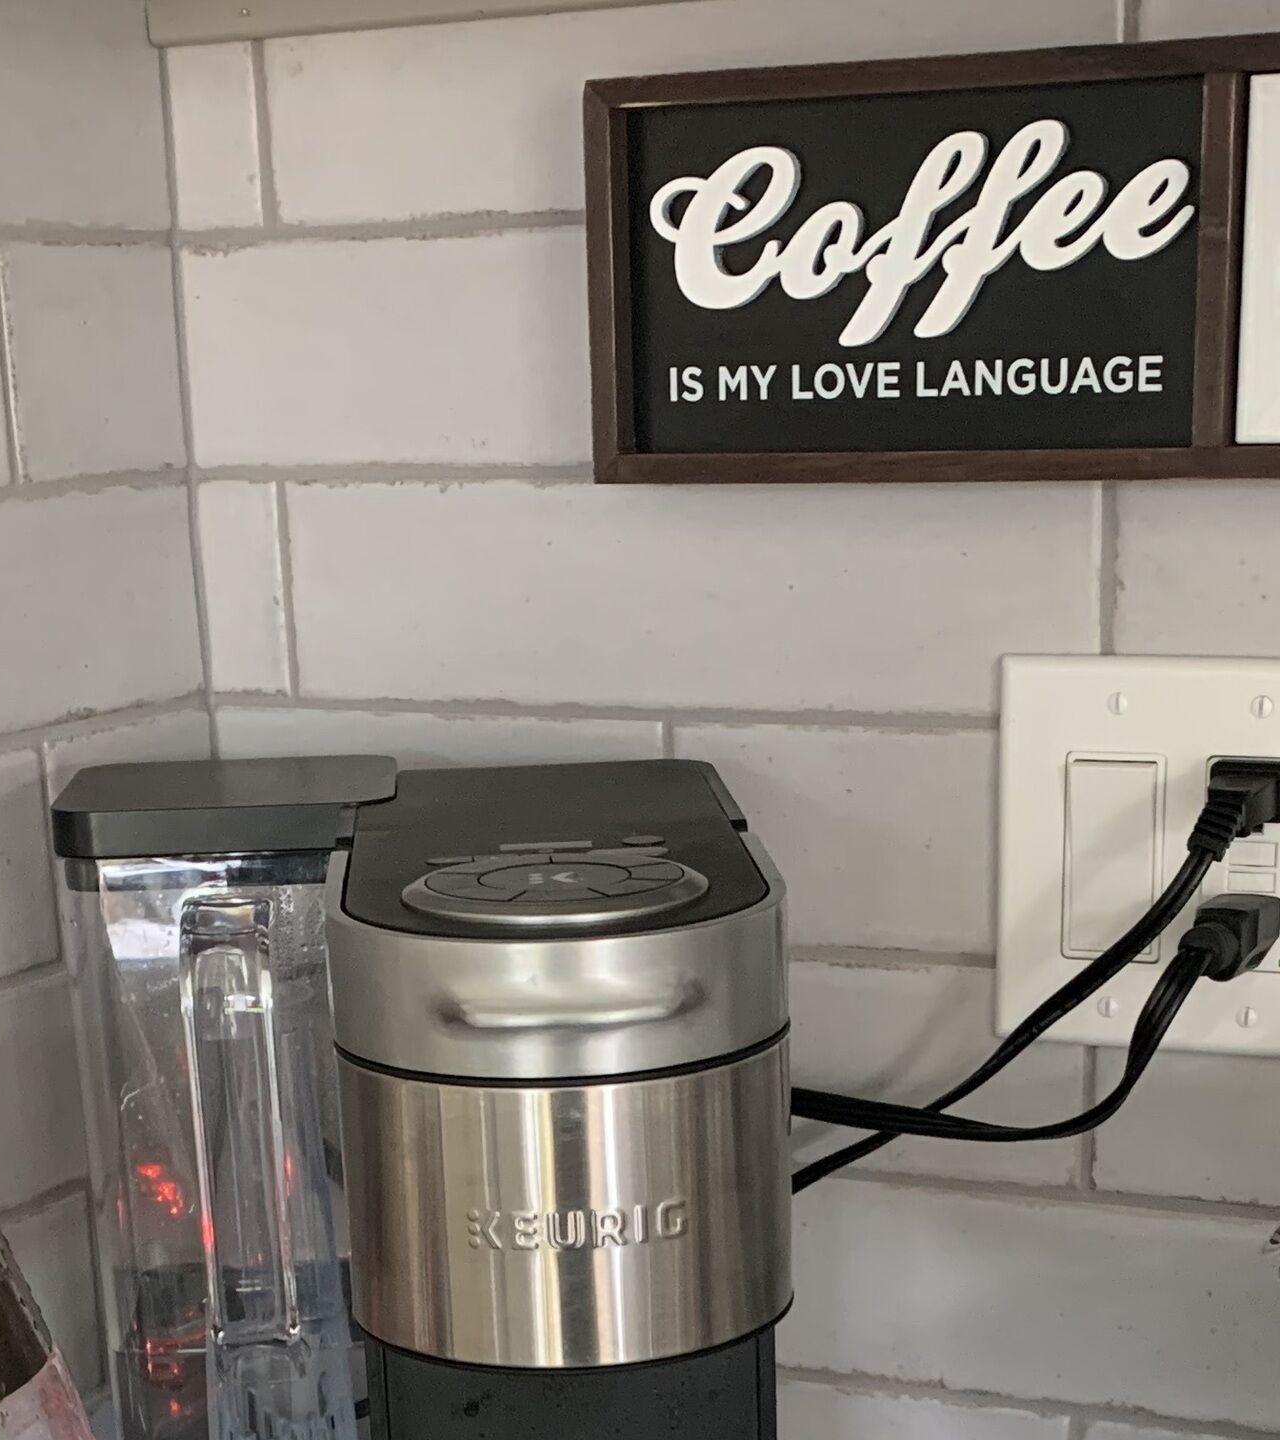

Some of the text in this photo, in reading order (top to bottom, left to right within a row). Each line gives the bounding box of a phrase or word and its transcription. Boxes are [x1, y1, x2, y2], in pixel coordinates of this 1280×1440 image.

[649, 118, 1195, 346] Coffee
[669, 355, 1165, 402] IS MY LOVE LANGUAGE
[466, 1197, 691, 1252] KEURIG
